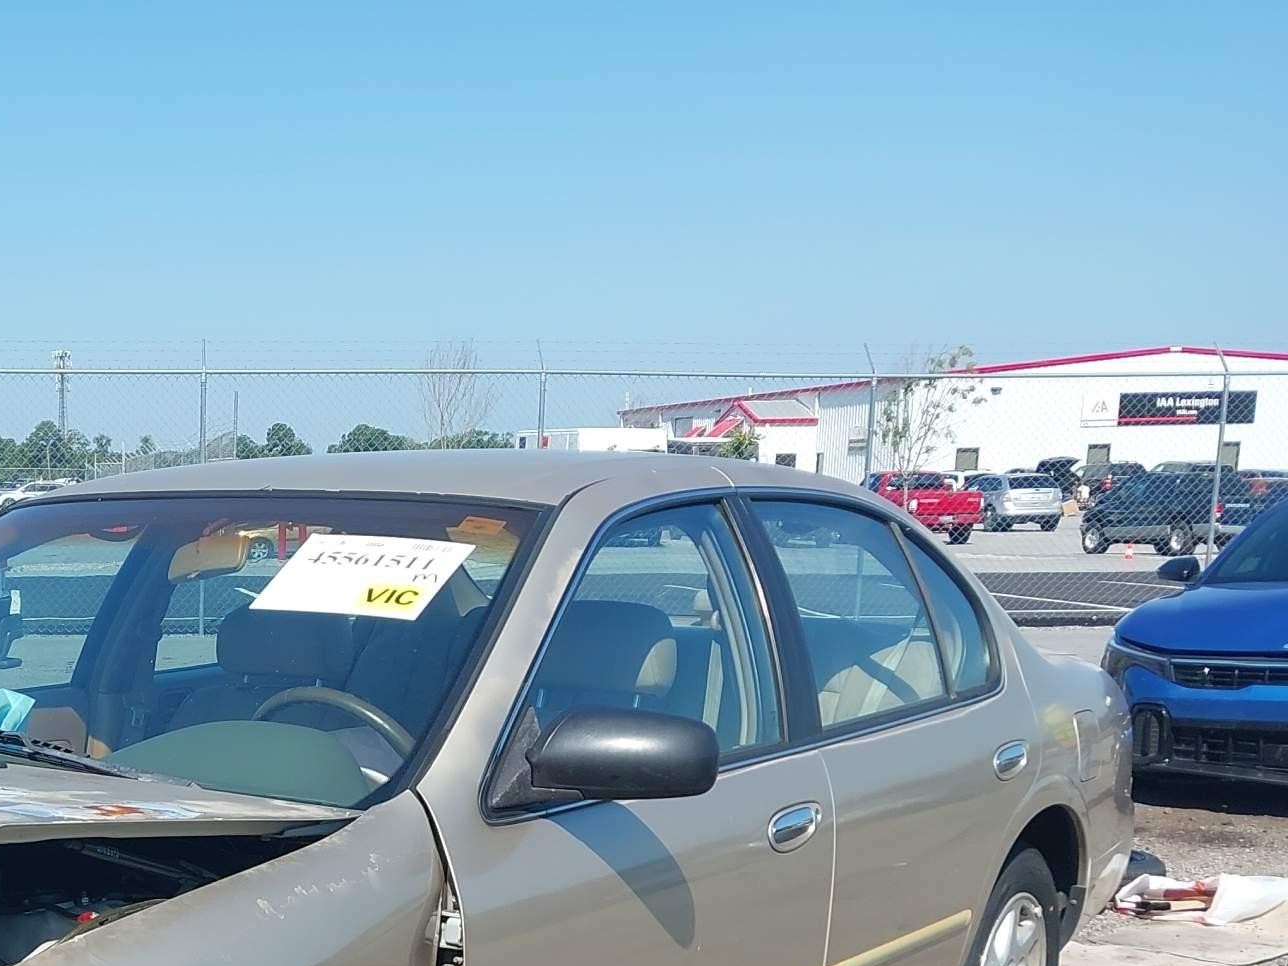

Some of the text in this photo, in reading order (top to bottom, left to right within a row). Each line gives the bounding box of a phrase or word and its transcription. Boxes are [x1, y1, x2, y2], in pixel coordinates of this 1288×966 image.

[1156, 396, 1219, 408] IAA Lexington
[308, 551, 435, 570] 45561511
[366, 588, 419, 605] VIC
